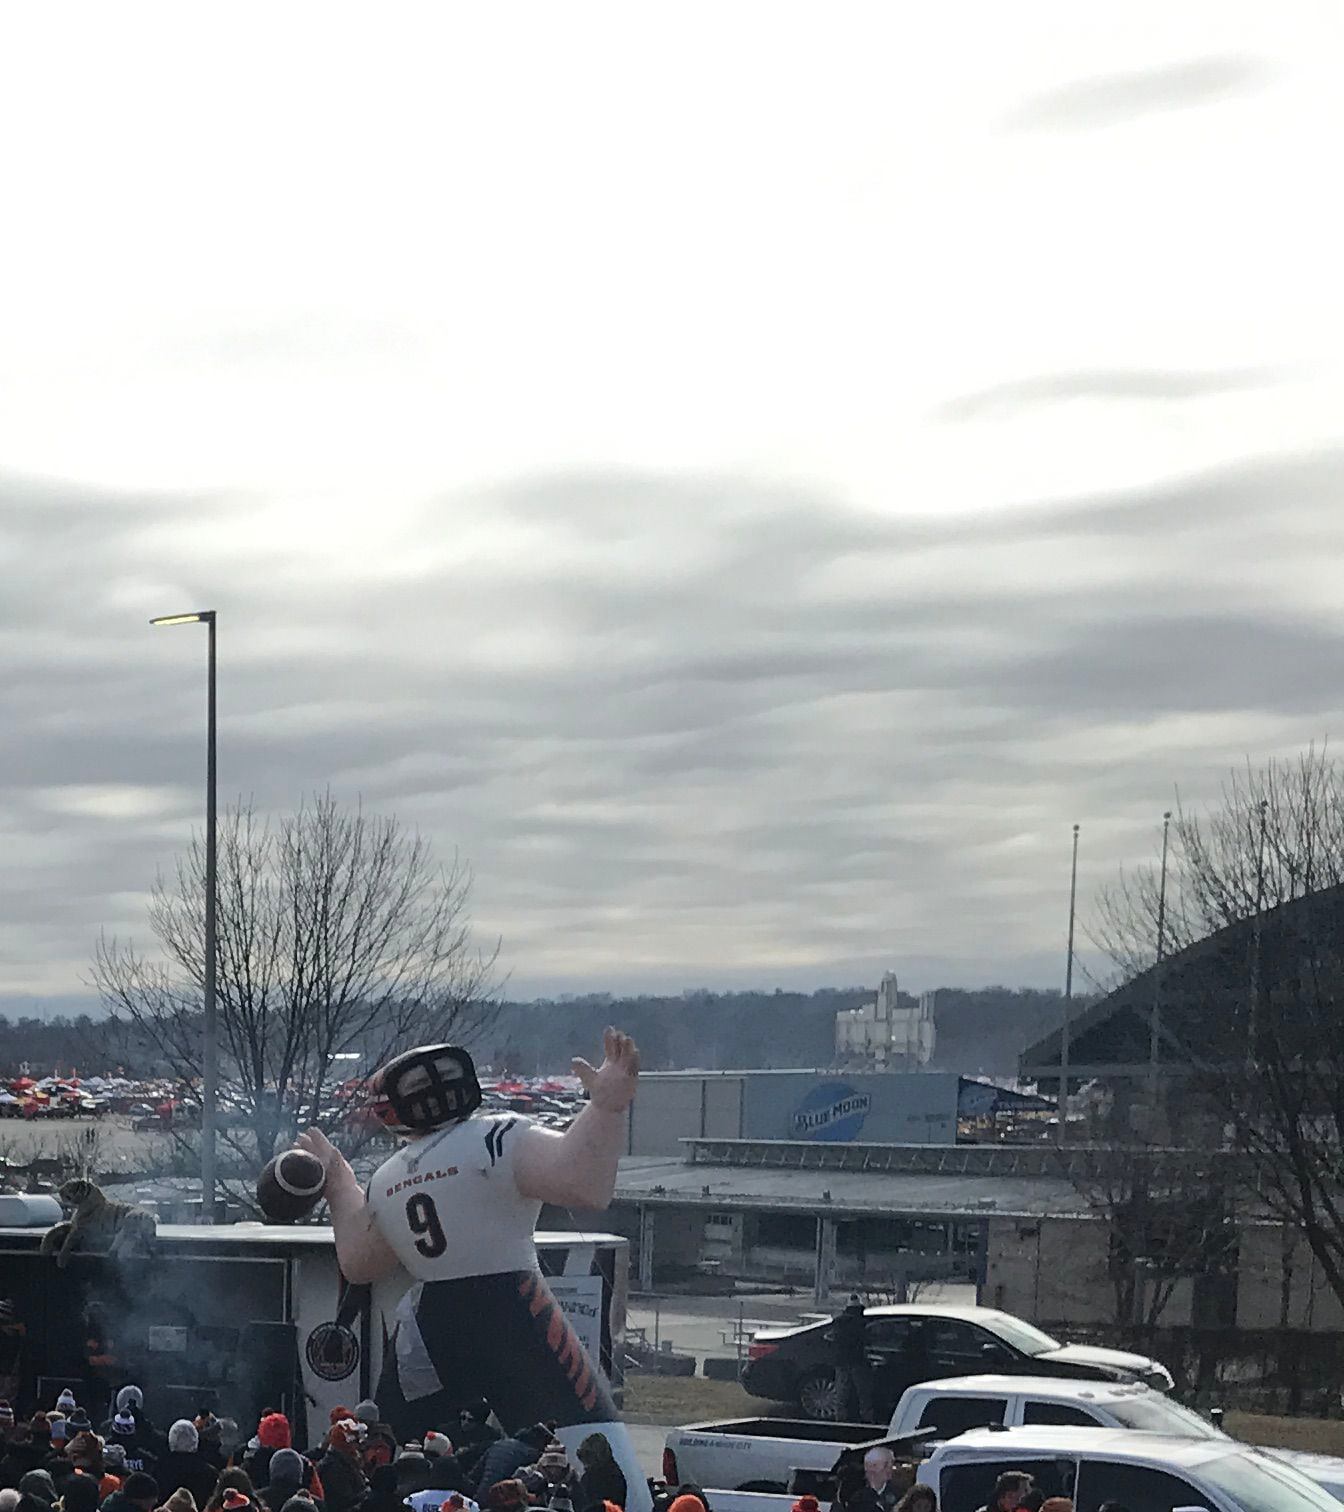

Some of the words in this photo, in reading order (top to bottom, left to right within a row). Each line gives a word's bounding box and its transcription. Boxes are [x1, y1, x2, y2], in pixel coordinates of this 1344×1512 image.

[832, 1096, 868, 1117] MOON
[386, 1166, 459, 1197] BENGALS
[406, 1192, 447, 1258] 9
